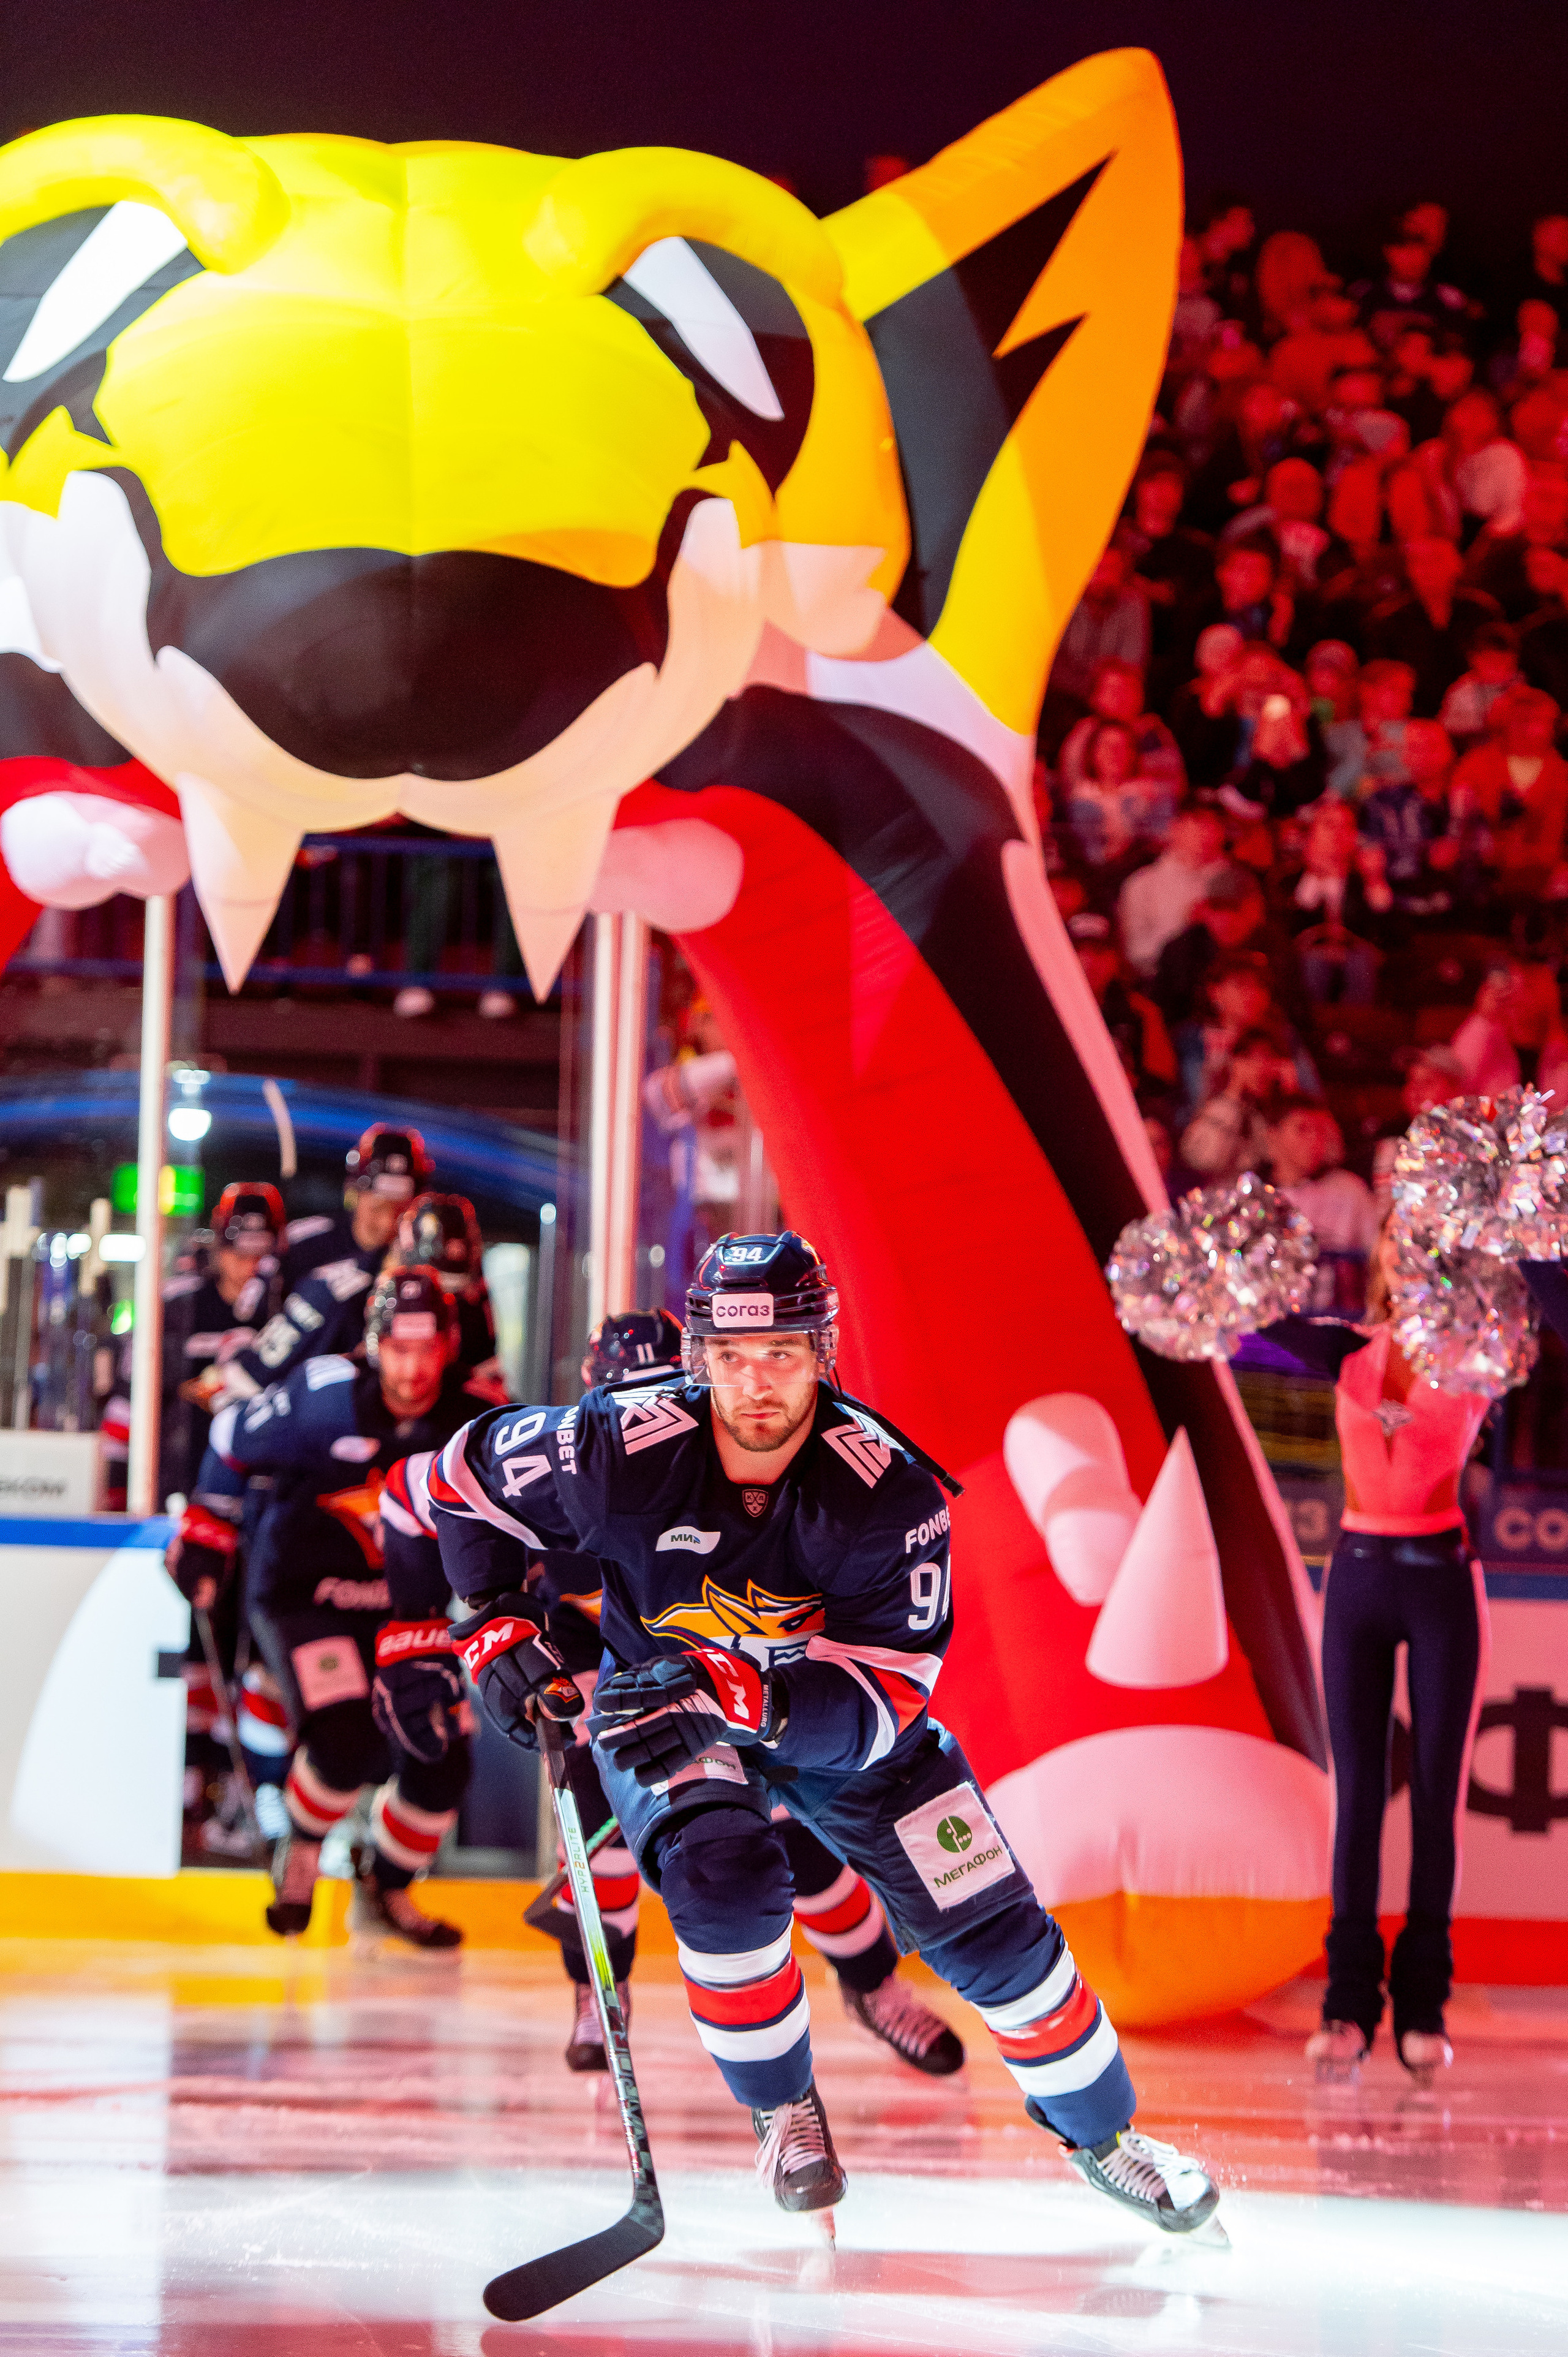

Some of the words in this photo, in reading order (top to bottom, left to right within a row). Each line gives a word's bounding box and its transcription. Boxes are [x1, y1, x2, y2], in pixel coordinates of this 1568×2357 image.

[731, 1246, 763, 1262] 94
[716, 1305, 770, 1317] согаз
[556, 1405, 580, 1475] ONBET
[494, 1412, 552, 1499] 94
[670, 1534, 701, 1544] МИР
[760, 1684, 770, 1727] METALLURG
